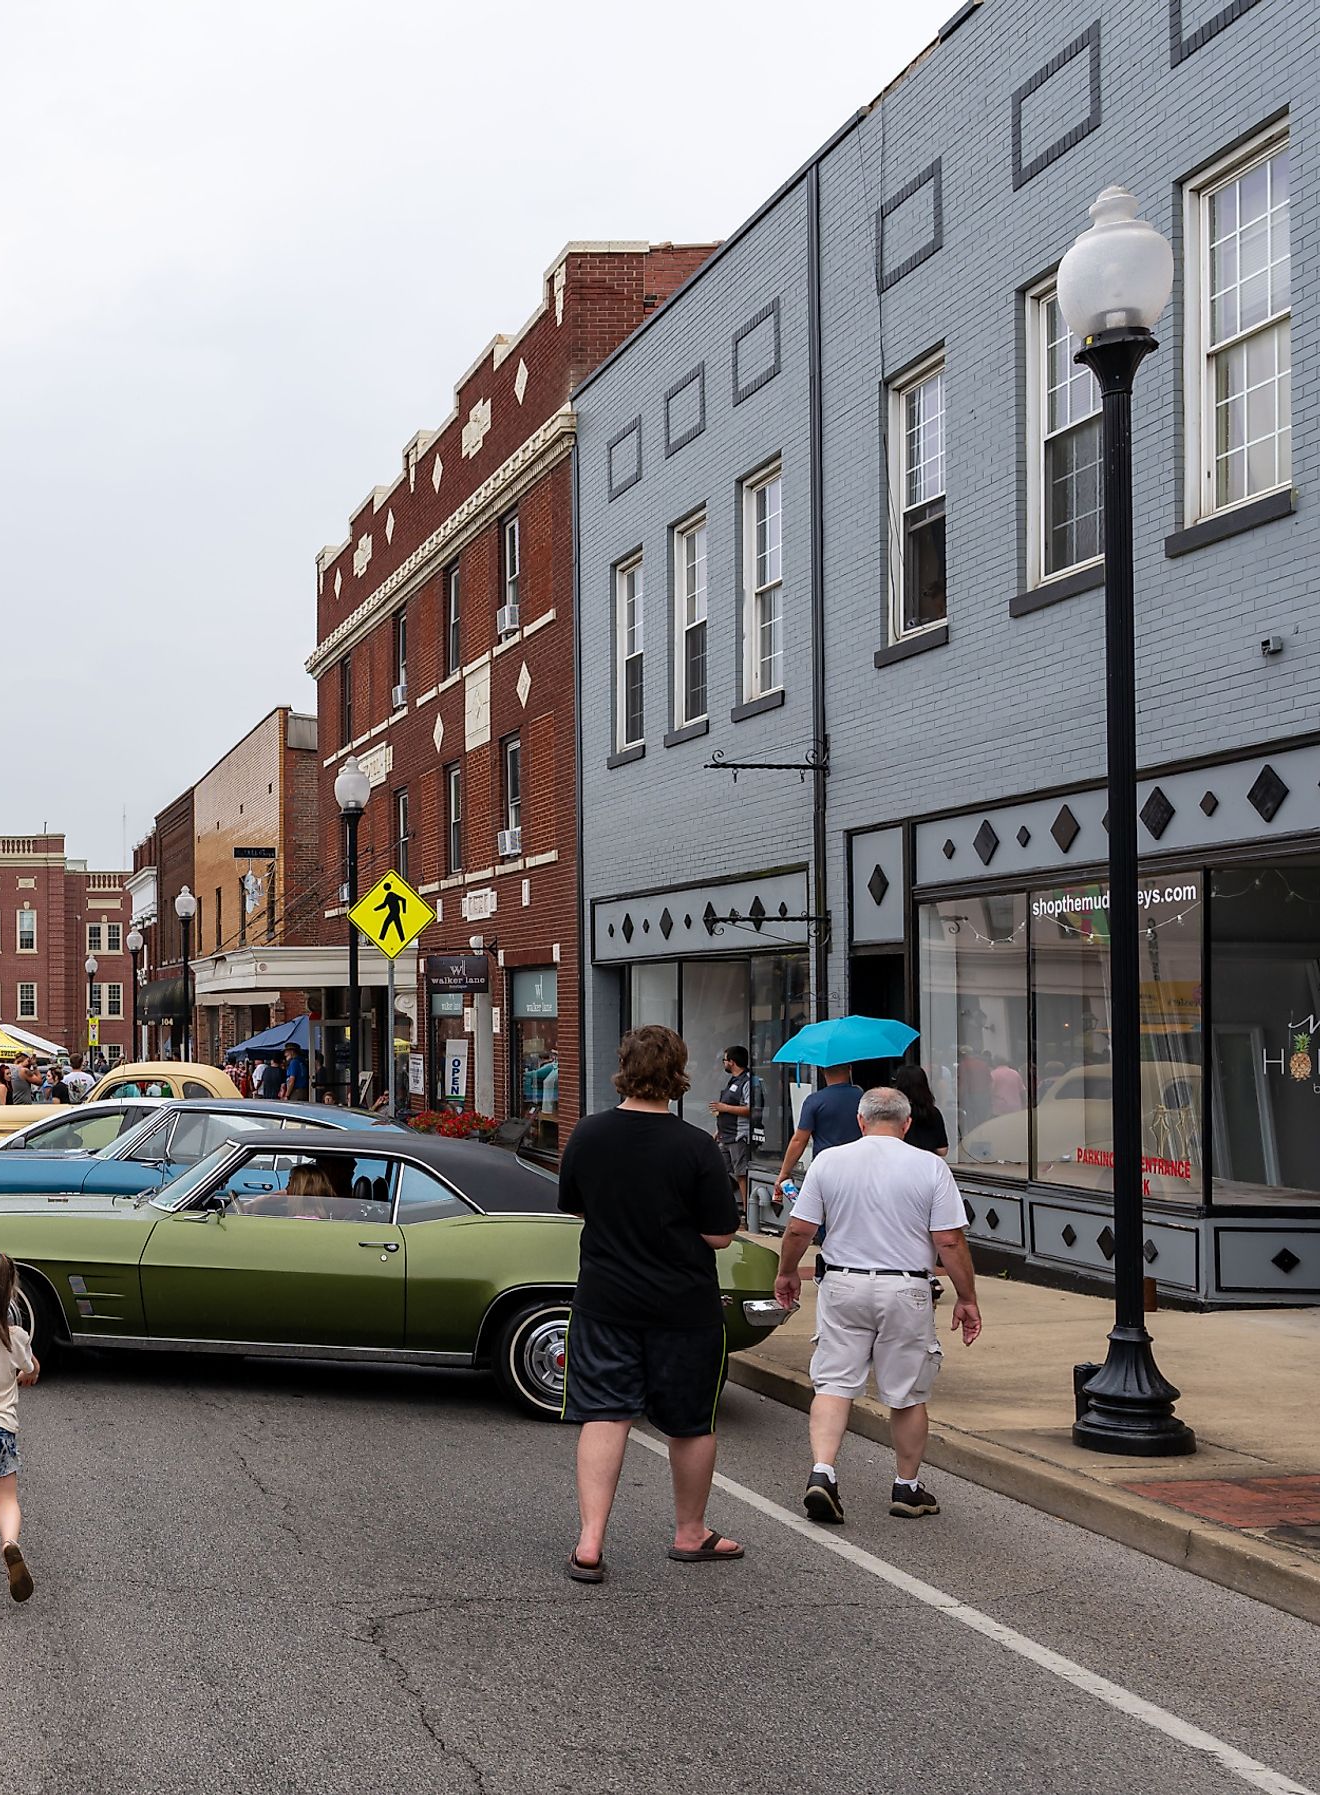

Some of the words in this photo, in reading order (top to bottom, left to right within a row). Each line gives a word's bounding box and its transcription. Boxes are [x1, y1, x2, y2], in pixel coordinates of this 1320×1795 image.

[430, 976, 463, 985] walker
[465, 976, 486, 984] lane
[451, 1058, 461, 1095] OPEN
